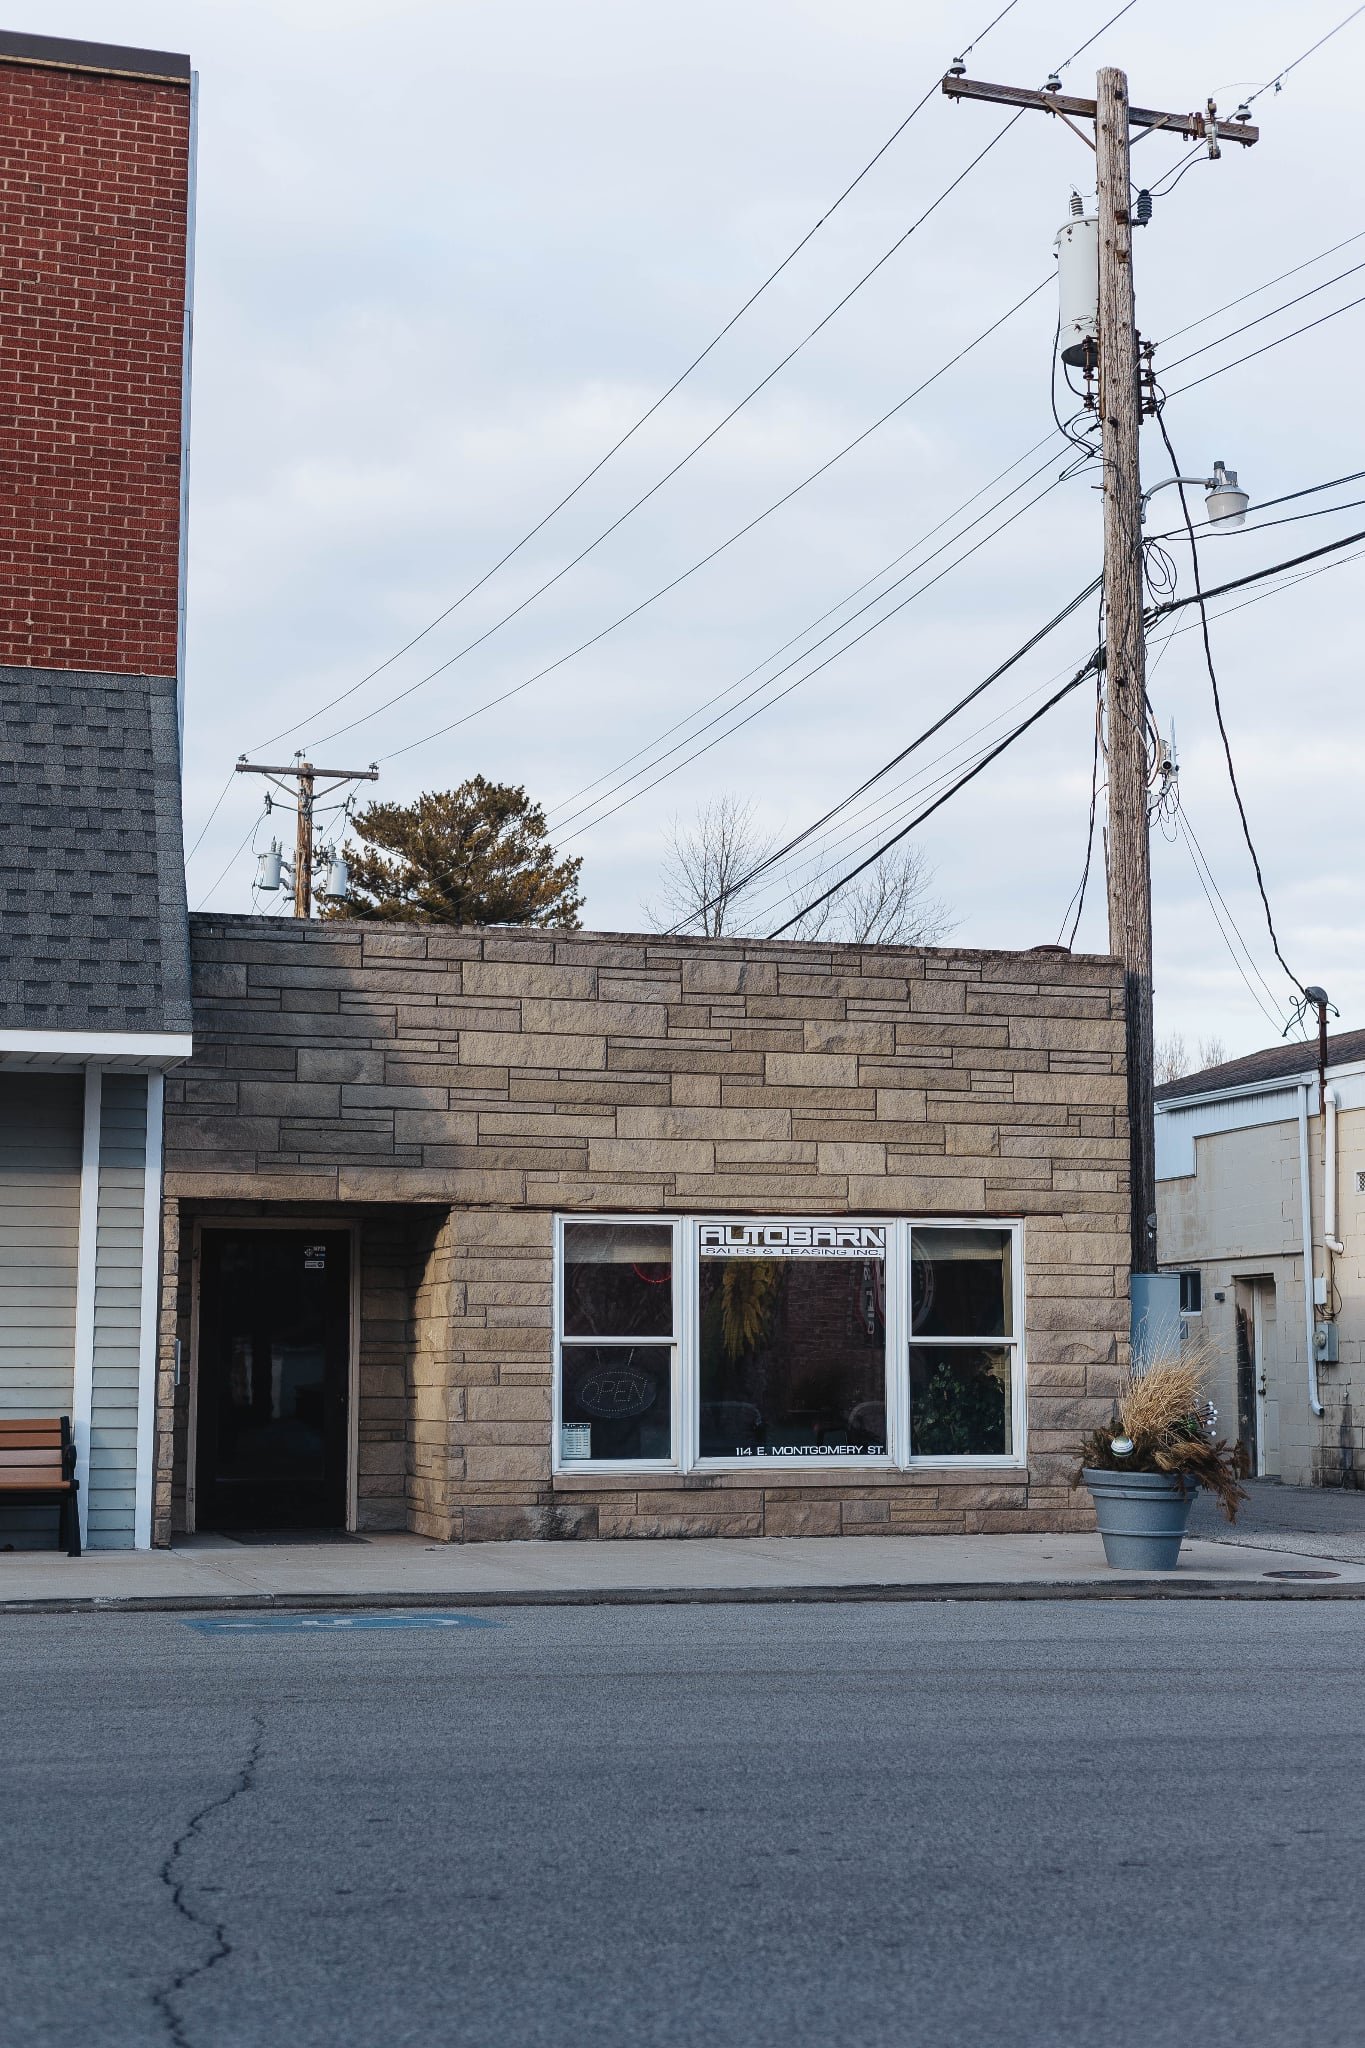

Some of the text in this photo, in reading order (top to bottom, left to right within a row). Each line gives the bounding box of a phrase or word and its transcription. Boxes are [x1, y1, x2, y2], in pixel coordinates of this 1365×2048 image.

[700, 1225, 885, 1247] AUTOBARN
[705, 1247, 882, 1256] SALES & LEASING INC.
[581, 1380, 648, 1405] OPEN
[736, 1445, 885, 1456] 114 E. MONTGOMERY ST.
